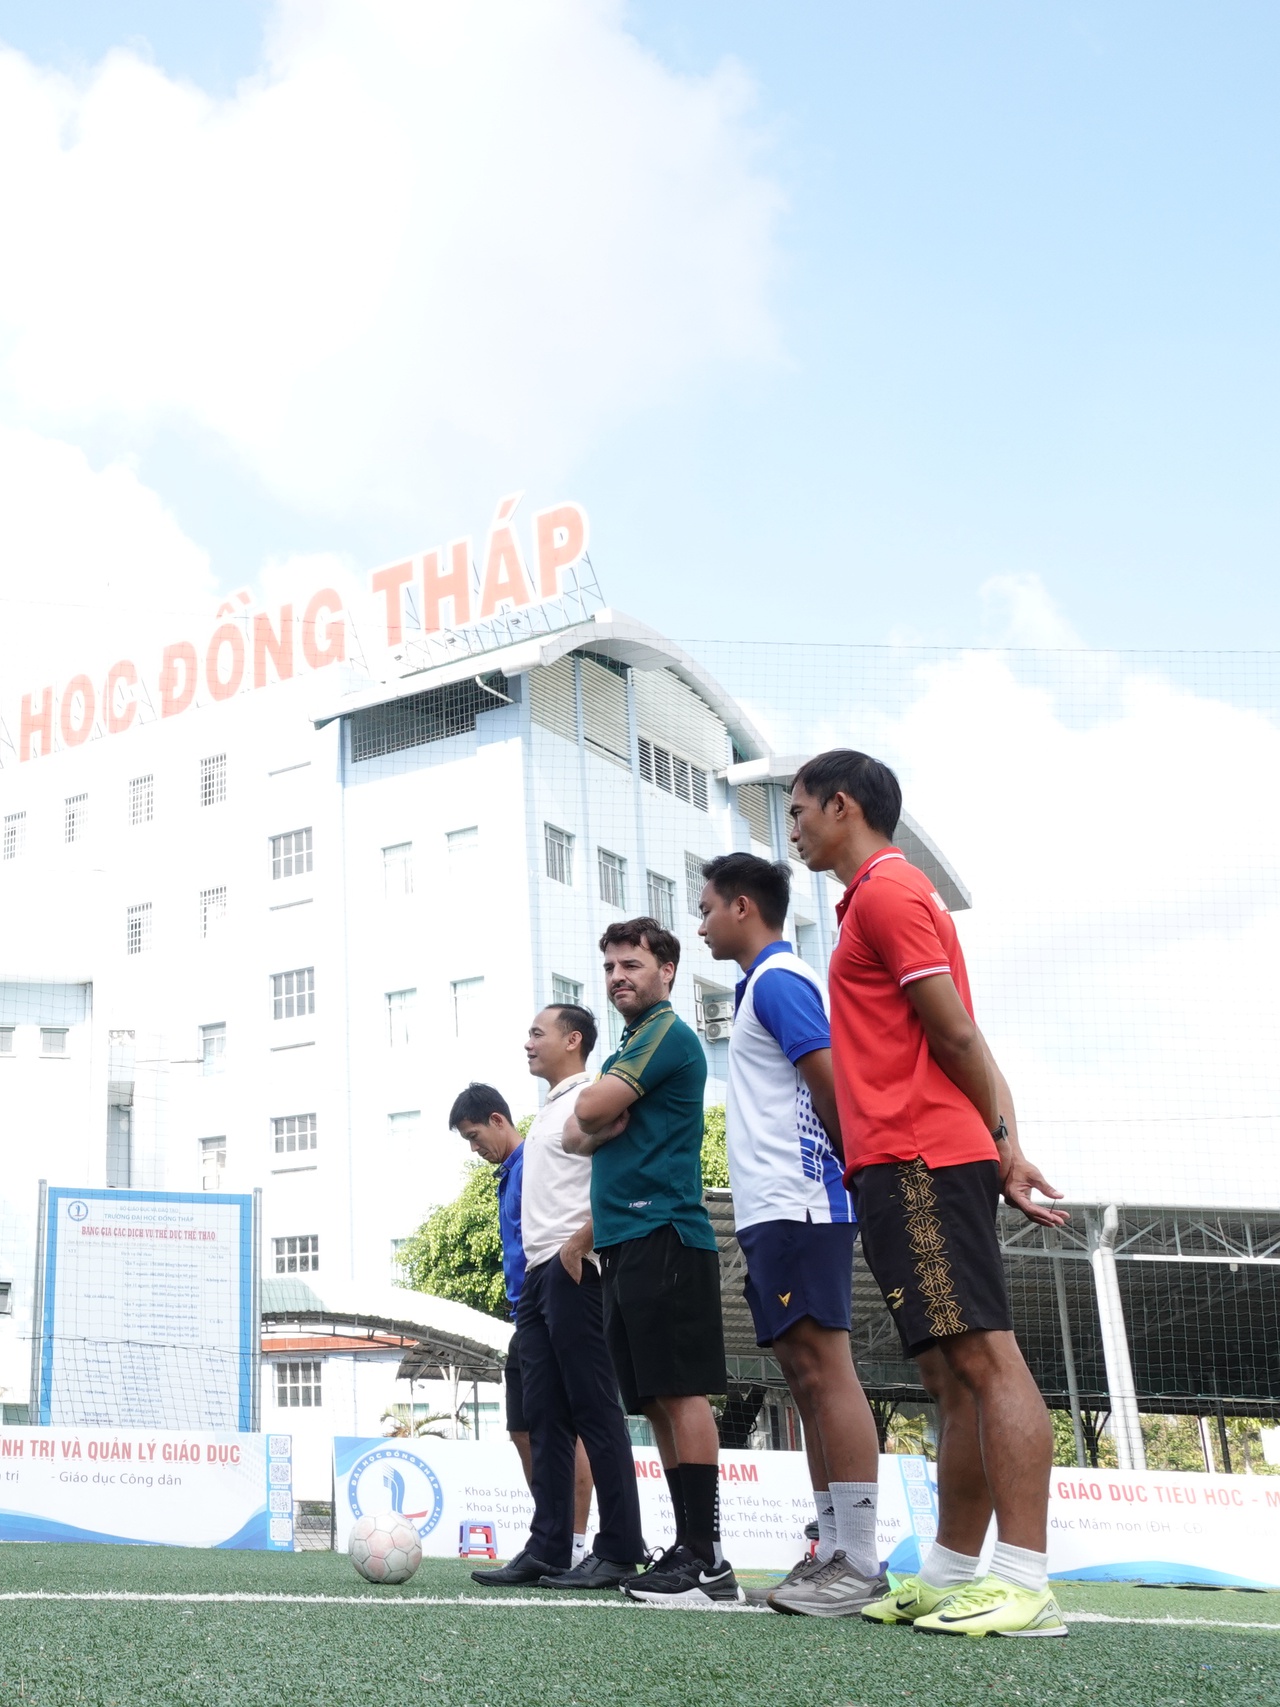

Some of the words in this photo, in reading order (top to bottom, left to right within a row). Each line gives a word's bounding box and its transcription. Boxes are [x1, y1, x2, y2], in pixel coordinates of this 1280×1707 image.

[159, 588, 345, 719] ĐỒNG
[372, 497, 584, 647] THÁP
[30, 1440, 55, 1462] TRỊ
[61, 1436, 82, 1458] VÀ
[88, 1437, 131, 1460] QUẢN
[138, 1439, 156, 1460] LÝ
[162, 1440, 200, 1462] GIÁO
[207, 1444, 240, 1466] DỤC
[5, 1470, 19, 1483] trị
[59, 1471, 88, 1483] Giáo
[92, 1472, 115, 1486] dục
[120, 1473, 153, 1487] Công
[157, 1473, 182, 1485] dân
[718, 1463, 759, 1485] HẠM
[465, 1487, 491, 1496] Khoa
[494, 1487, 507, 1497] Sư
[1057, 1478, 1102, 1500] GIÁO
[1108, 1484, 1148, 1506] DỤC
[1203, 1488, 1243, 1509] HỌC
[466, 1502, 492, 1512] Khoa
[496, 1503, 509, 1512] Sư
[737, 1496, 759, 1506] Tiểu
[762, 1498, 782, 1509] học
[497, 1519, 511, 1528] Sư
[739, 1512, 757, 1521] Thể
[760, 1512, 783, 1523] chất
[792, 1514, 805, 1524] Sư
[1050, 1517, 1075, 1531] dục
[1116, 1522, 1142, 1531] non
[721, 1528, 741, 1539] dục
[743, 1529, 773, 1539] chính
[776, 1531, 788, 1541] trị
[790, 1531, 803, 1540] và
